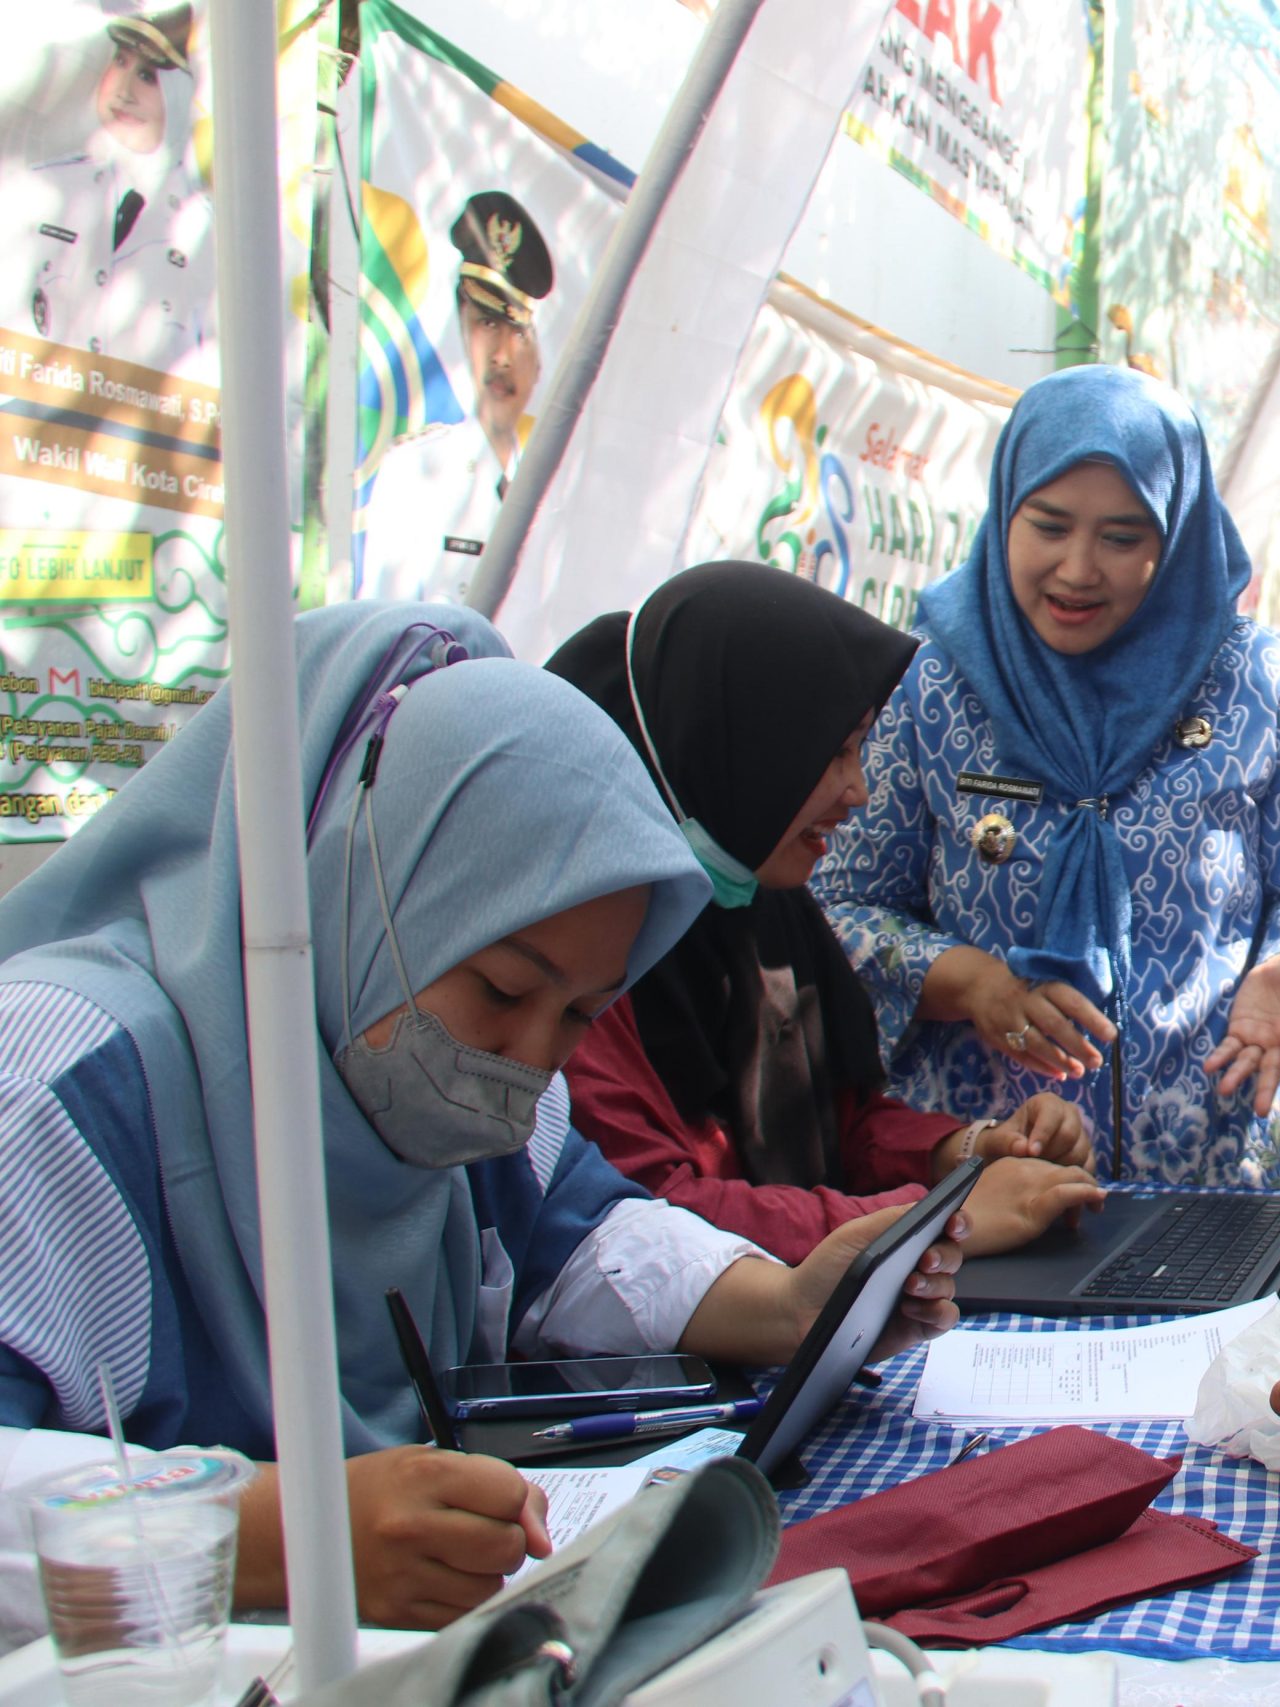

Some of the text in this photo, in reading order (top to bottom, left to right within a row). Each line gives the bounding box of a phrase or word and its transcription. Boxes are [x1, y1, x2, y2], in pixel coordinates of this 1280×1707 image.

[19, 352, 84, 392] Farida
[13, 435, 79, 471] Wakil
[131, 462, 178, 493] Kota
[183, 475, 224, 504] Cire
[862, 484, 934, 567] HARI
[27, 556, 77, 581] LEBIH
[83, 558, 145, 582] LANJUT
